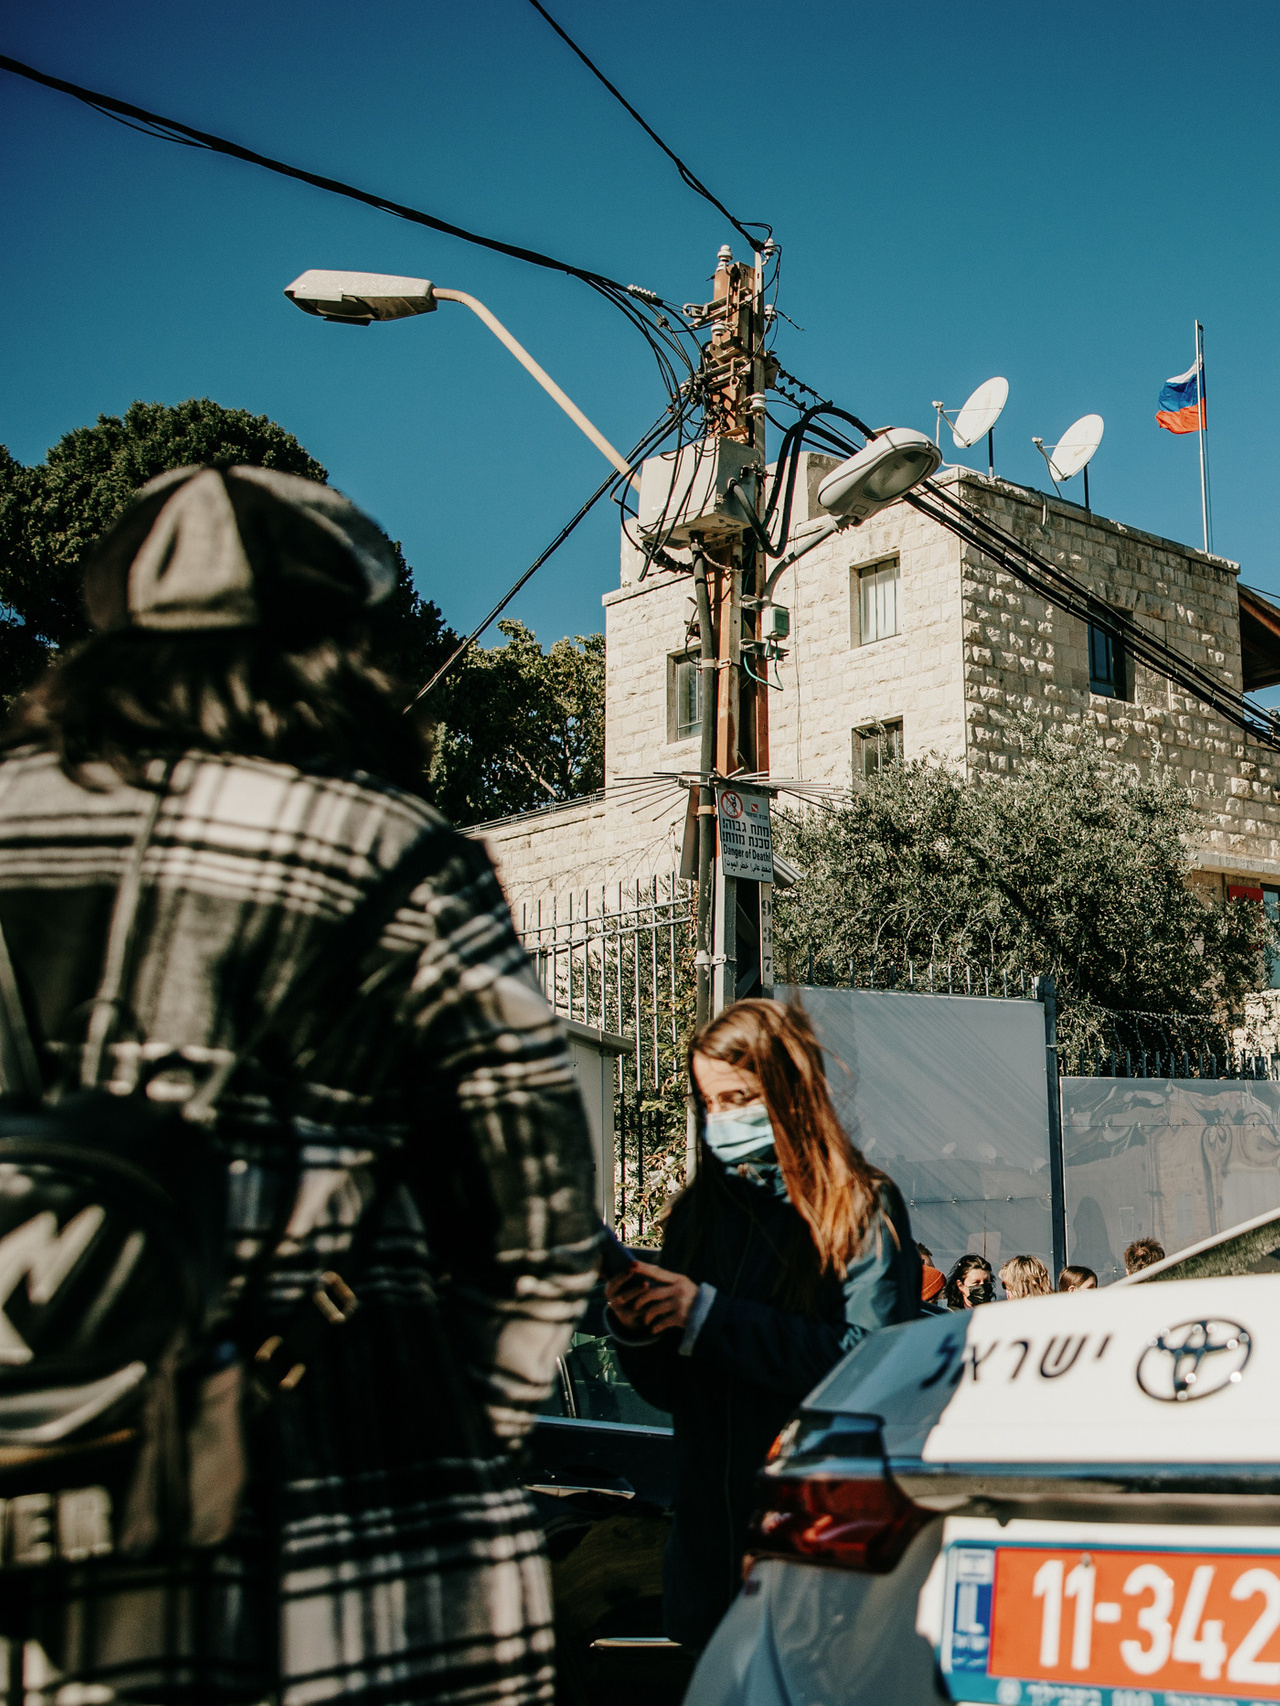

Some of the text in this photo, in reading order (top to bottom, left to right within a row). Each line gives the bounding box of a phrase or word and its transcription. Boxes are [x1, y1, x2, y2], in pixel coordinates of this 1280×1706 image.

[723, 818, 769, 837] מתח גבוה!
[723, 831, 769, 849] סכנת מוות!
[724, 844, 771, 862] Danger of Death!
[919, 1332, 1115, 1390] ישראל
